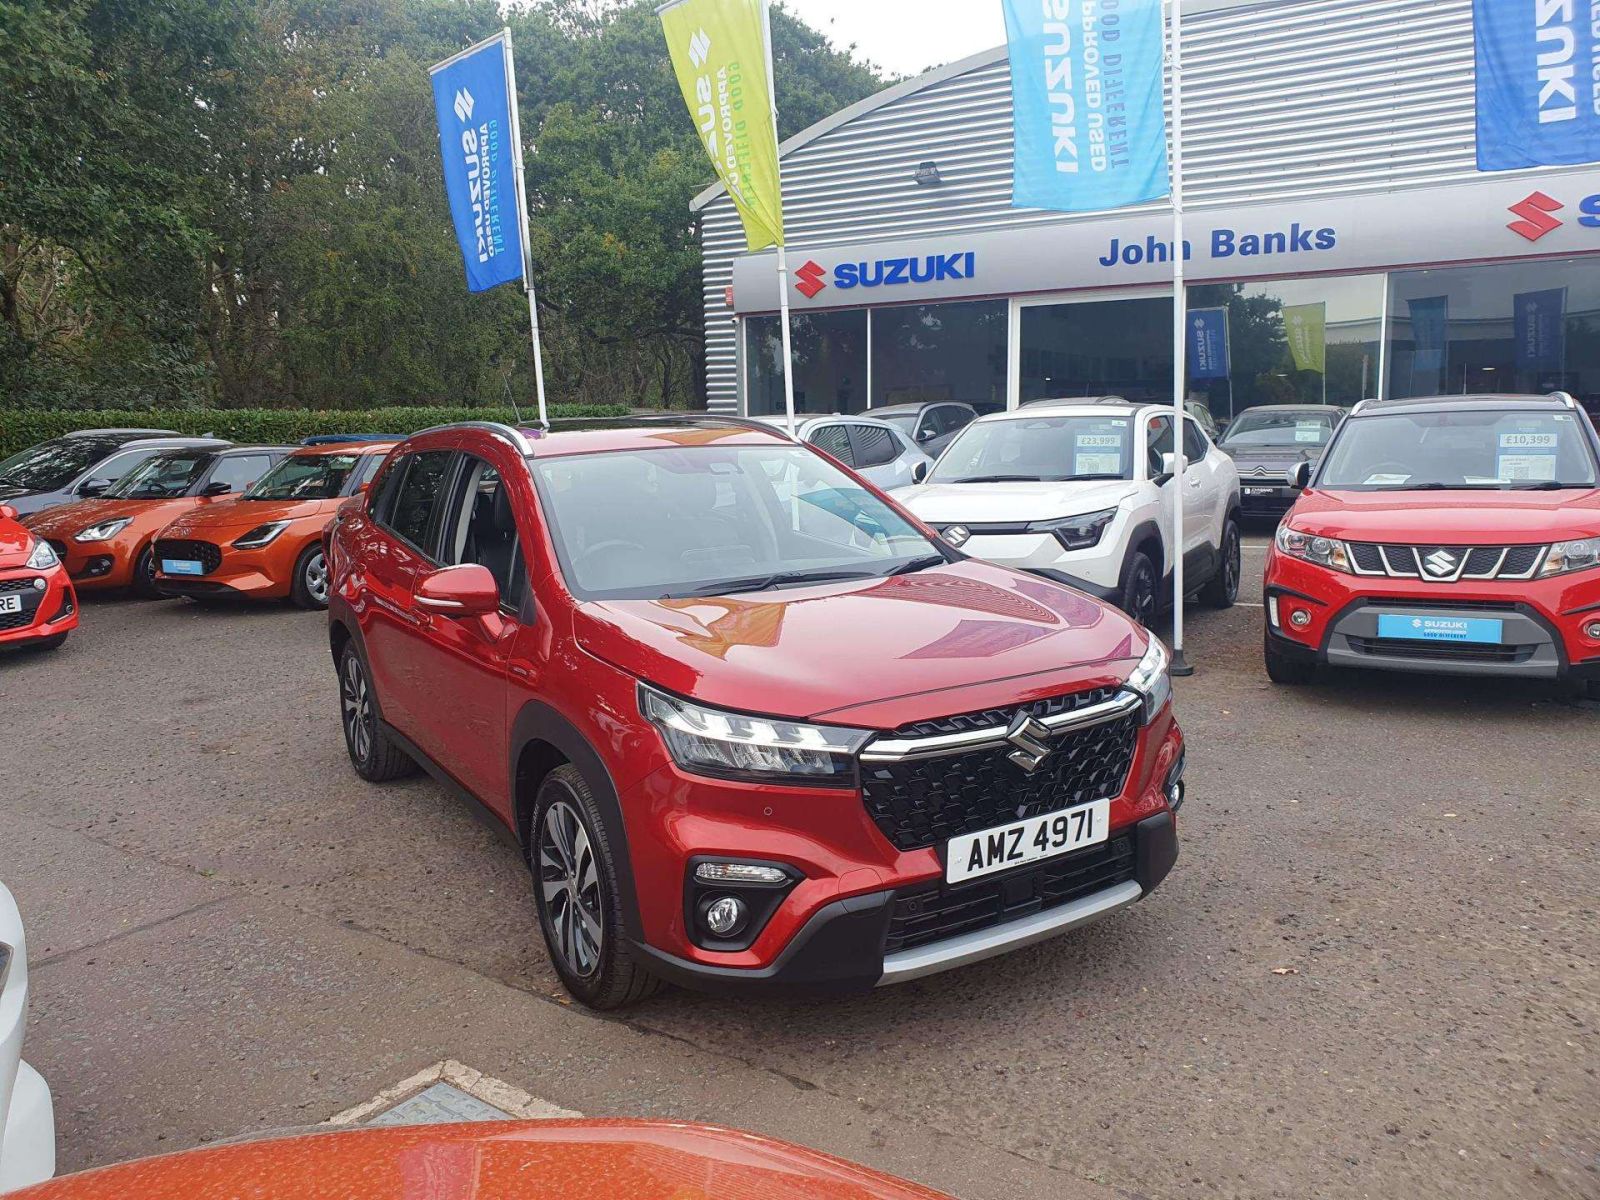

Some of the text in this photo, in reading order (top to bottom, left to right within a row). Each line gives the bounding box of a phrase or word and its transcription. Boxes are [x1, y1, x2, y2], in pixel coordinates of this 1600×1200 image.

[1099, 223, 1336, 267] John Banks
[834, 252, 975, 289] SUZUKI
[1505, 435, 1551, 446] £10,399
[967, 808, 1094, 873] AMZ 4971
